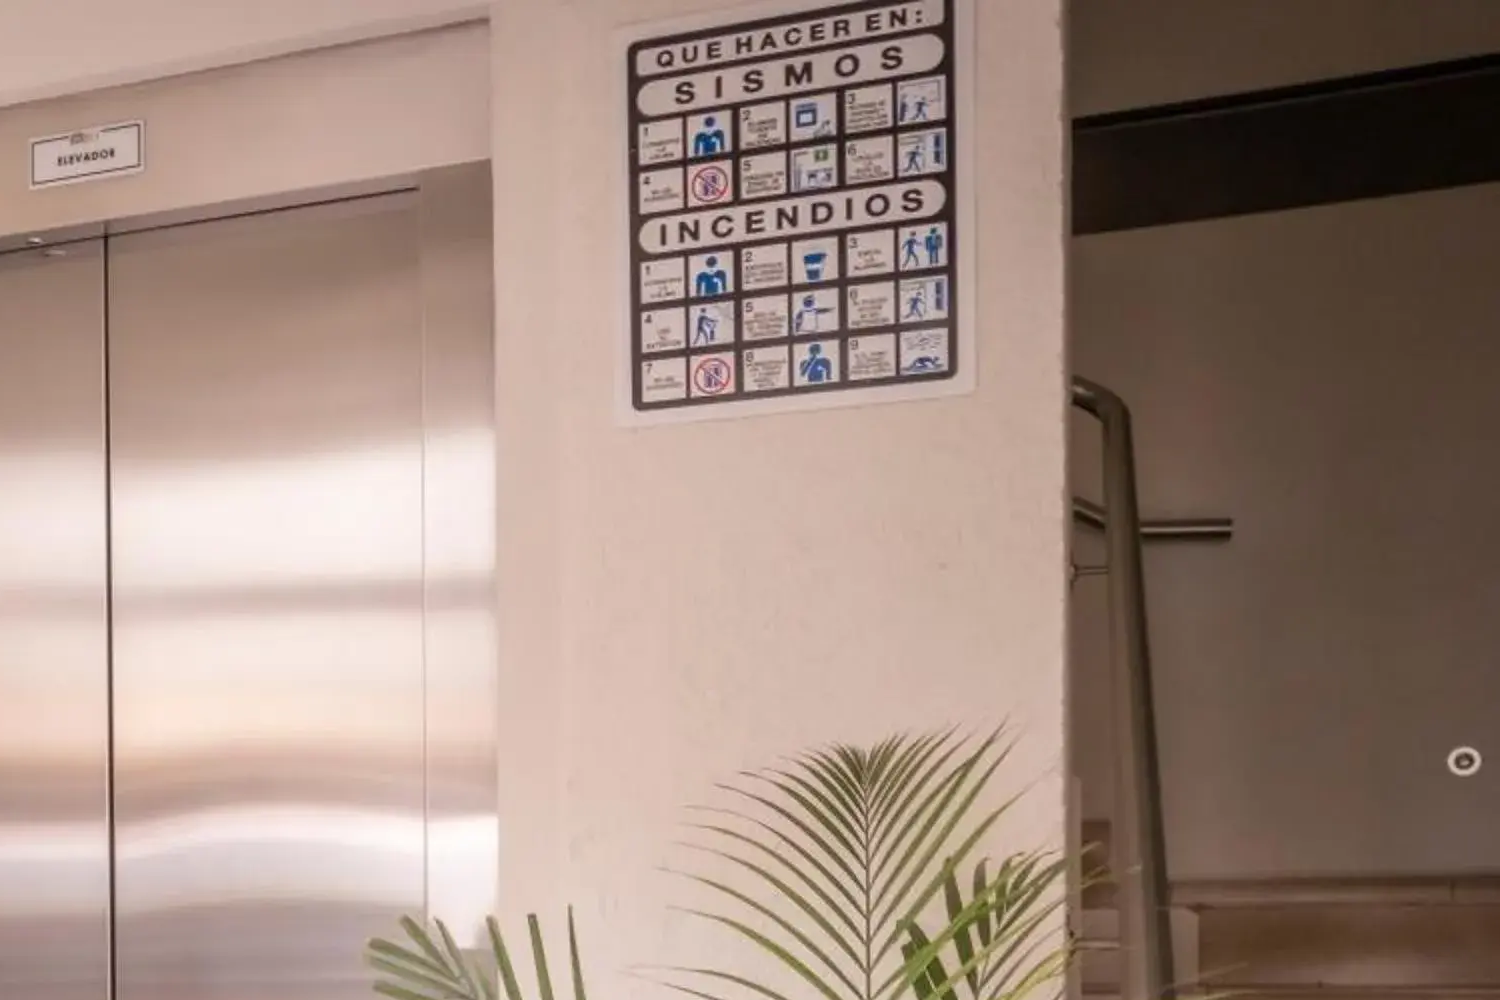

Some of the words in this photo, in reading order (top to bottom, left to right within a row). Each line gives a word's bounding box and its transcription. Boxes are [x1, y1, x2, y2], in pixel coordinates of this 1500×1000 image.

[656, 41, 721, 68] QUE
[735, 19, 850, 54] HACER
[865, 8, 923, 32] EN:
[674, 46, 903, 105] SISMOS
[742, 110, 751, 121] 2
[57, 147, 115, 167] ELEVADOR
[743, 160, 751, 171] 5
[660, 188, 924, 246] INCENDIOS
[850, 237, 857, 248] 3
[744, 251, 753, 262] 2
[745, 301, 753, 312] 5
[644, 314, 652, 323] 4
[850, 339, 858, 350] 9
[646, 363, 653, 373] 7
